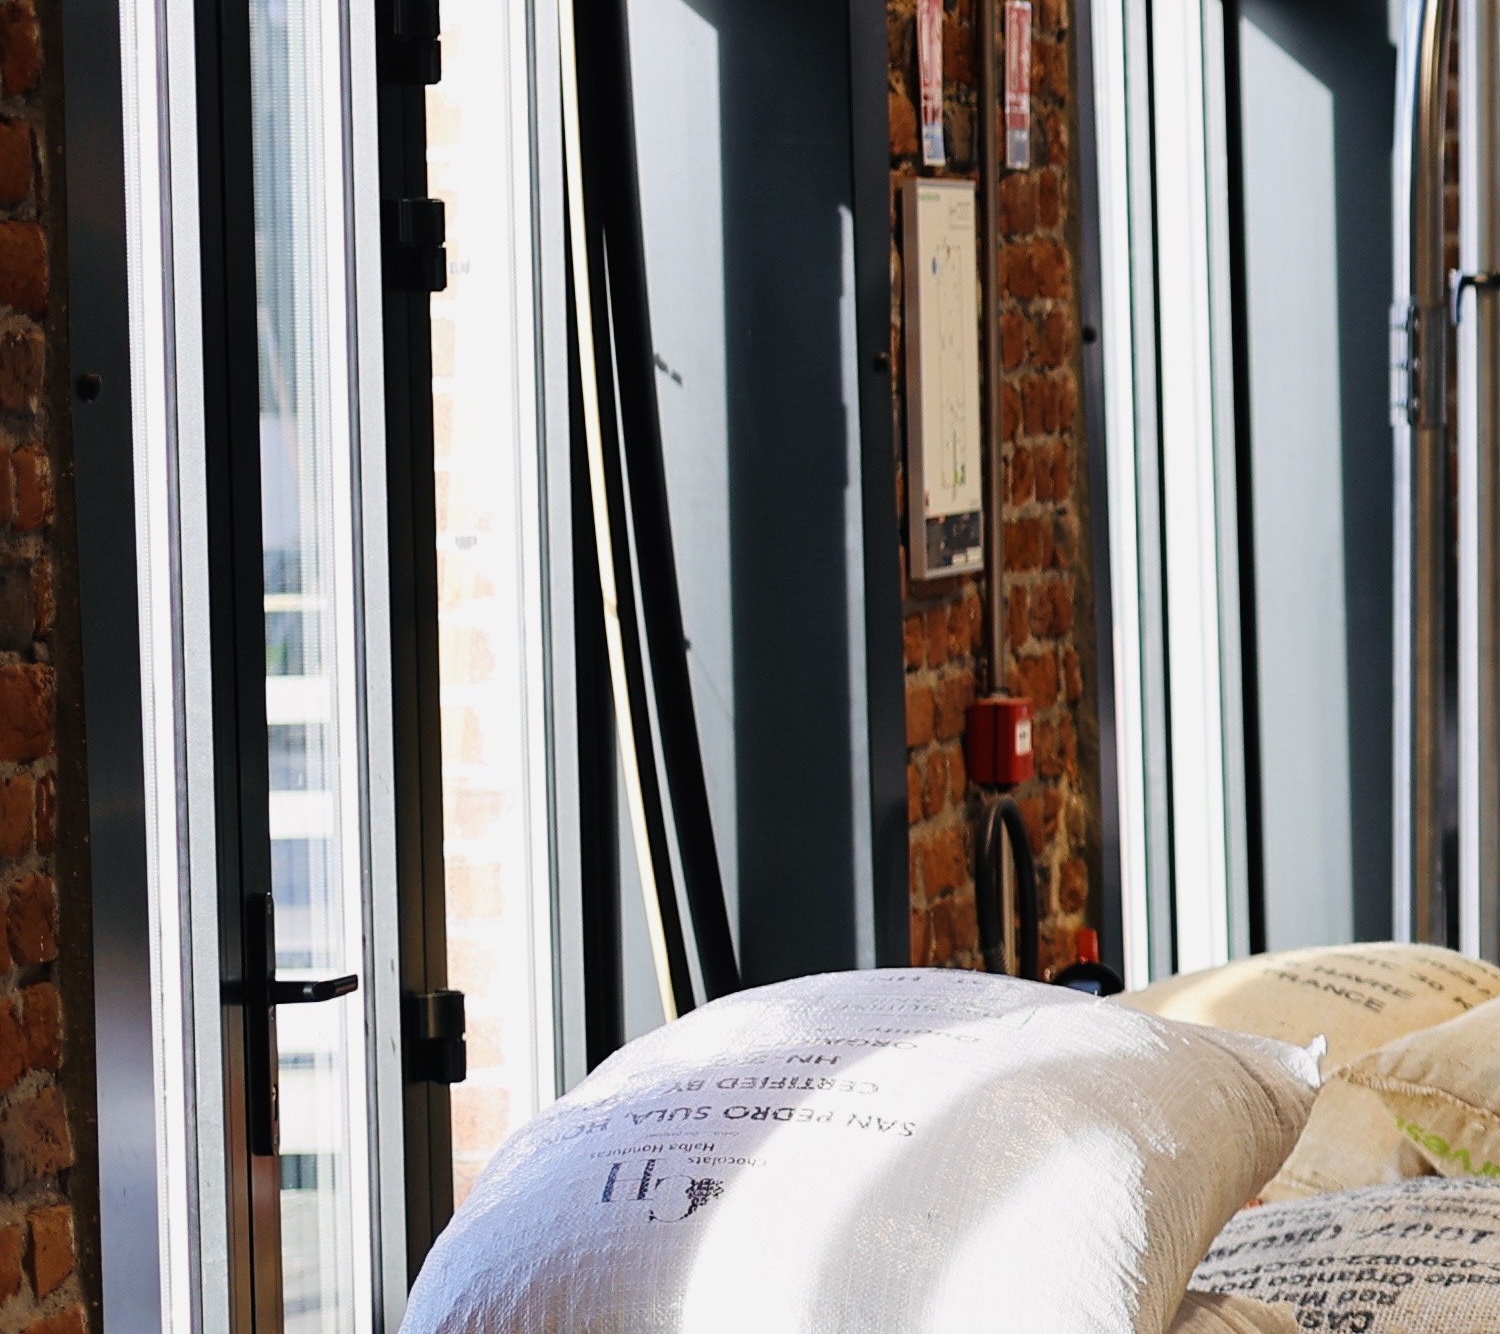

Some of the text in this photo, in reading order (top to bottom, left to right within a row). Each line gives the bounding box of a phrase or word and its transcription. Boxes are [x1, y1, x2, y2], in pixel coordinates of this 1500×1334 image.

[1312, 965, 1418, 1001] HAVRE
[715, 1075, 880, 1095] CERTIFIED
[721, 1104, 835, 1125] PEDRO
[848, 1113, 918, 1138] SAN
[589, 1141, 716, 1161] Halba Honduras
[687, 1154, 768, 1169] Chocolats
[1337, 1291, 1398, 1309] Red
